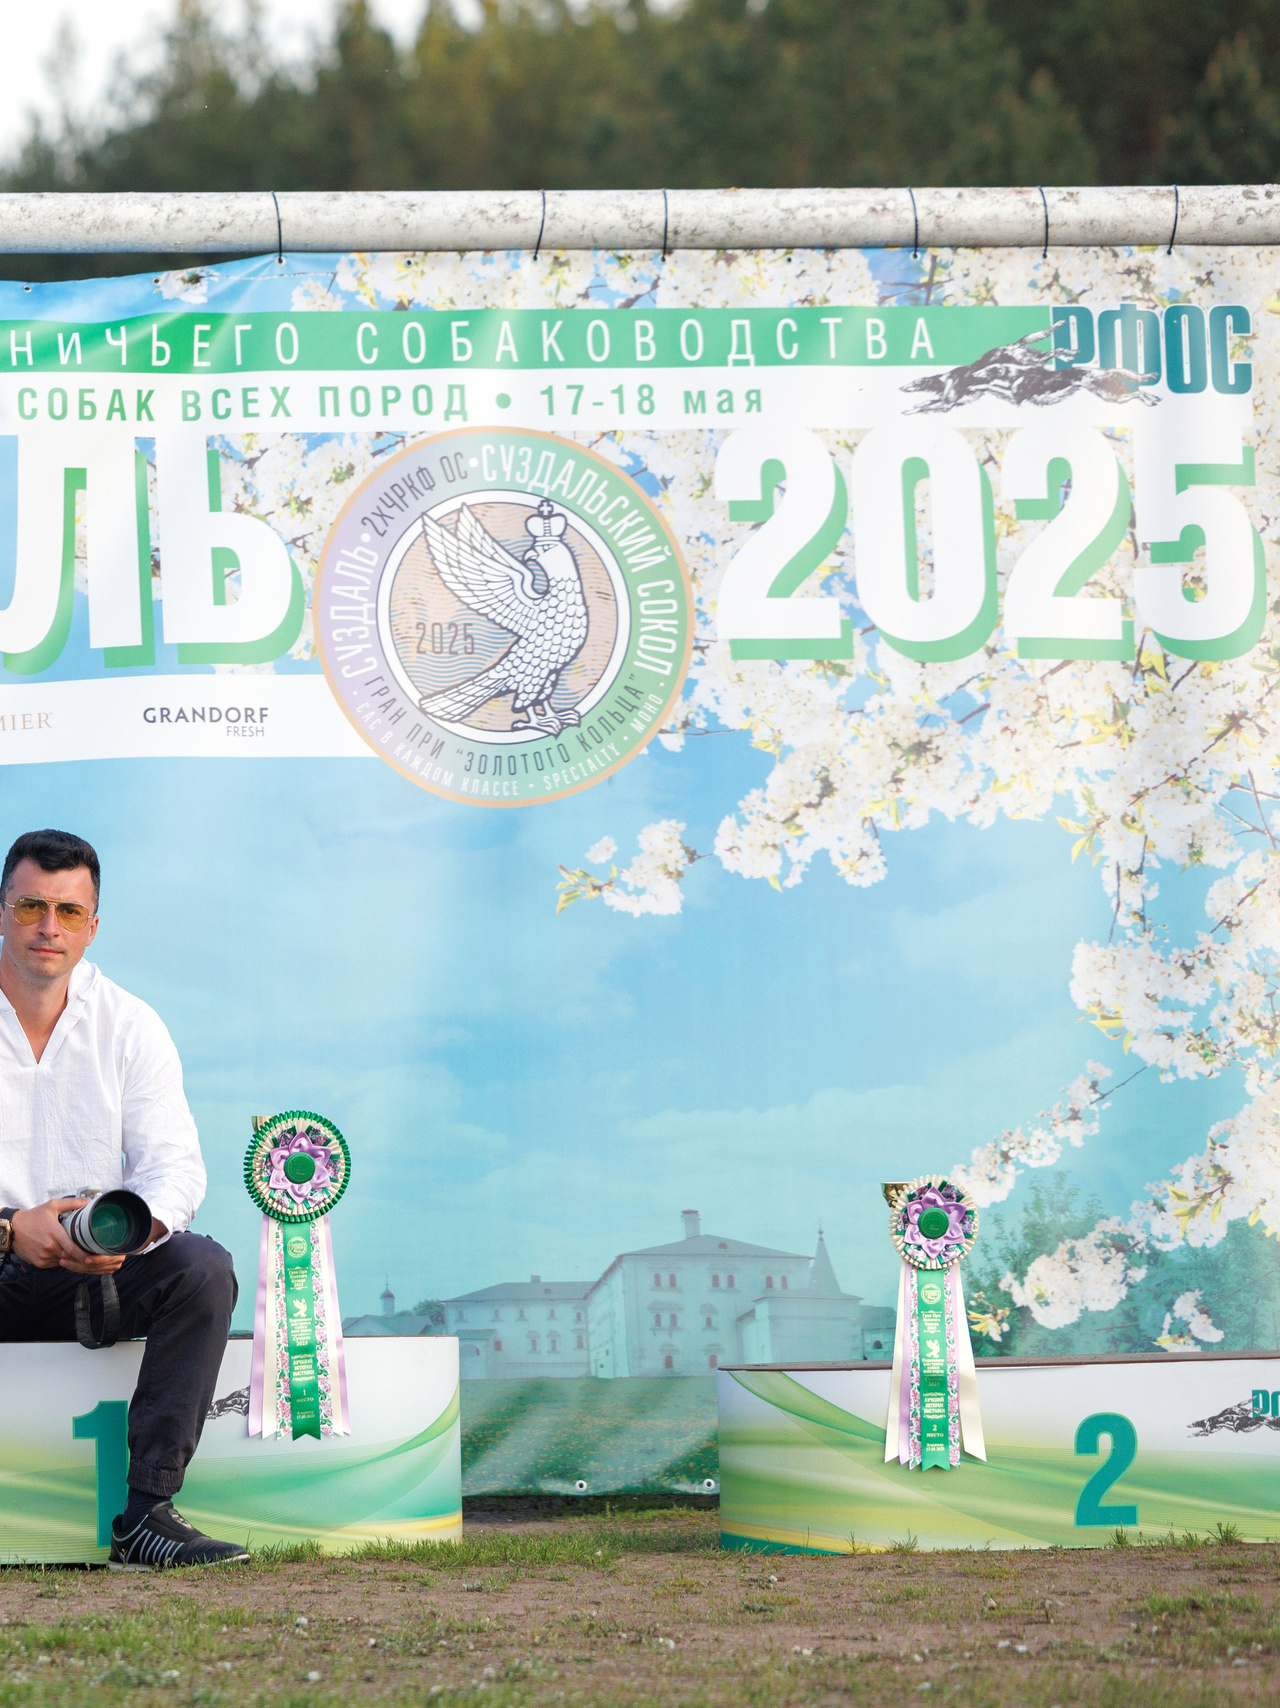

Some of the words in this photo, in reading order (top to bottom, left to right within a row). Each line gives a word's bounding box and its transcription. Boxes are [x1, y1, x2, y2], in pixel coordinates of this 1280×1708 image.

[356, 317, 935, 367] СОБАКОВОДСТВА
[1050, 303, 1254, 396] РФОС
[17, 386, 156, 422] СОБАК
[180, 385, 293, 422] ВСЕХ
[319, 383, 469, 422] ПОРОД
[539, 383, 657, 417] 17-18
[683, 388, 764, 415] мая
[481, 443, 672, 575] СУЗДАЛЬСКИЙ
[633, 578, 679, 677] СОКОЛ
[714, 424, 1267, 663] 2025
[329, 540, 381, 680] СУЗДАЛЬ
[415, 621, 475, 655] 2025
[142, 706, 270, 725] GRANDORF
[226, 725, 266, 738] FRESH
[364, 675, 407, 726] ГРАН
[405, 722, 446, 760] ПРИ
[629, 693, 664, 734] МОНО
[393, 741, 453, 787] КАЖДОМ
[460, 776, 520, 797] КЛАССЕ
[542, 745, 622, 791] SPECIALTY
[72, 1400, 130, 1548] 1
[1073, 1411, 1139, 1529] 2
